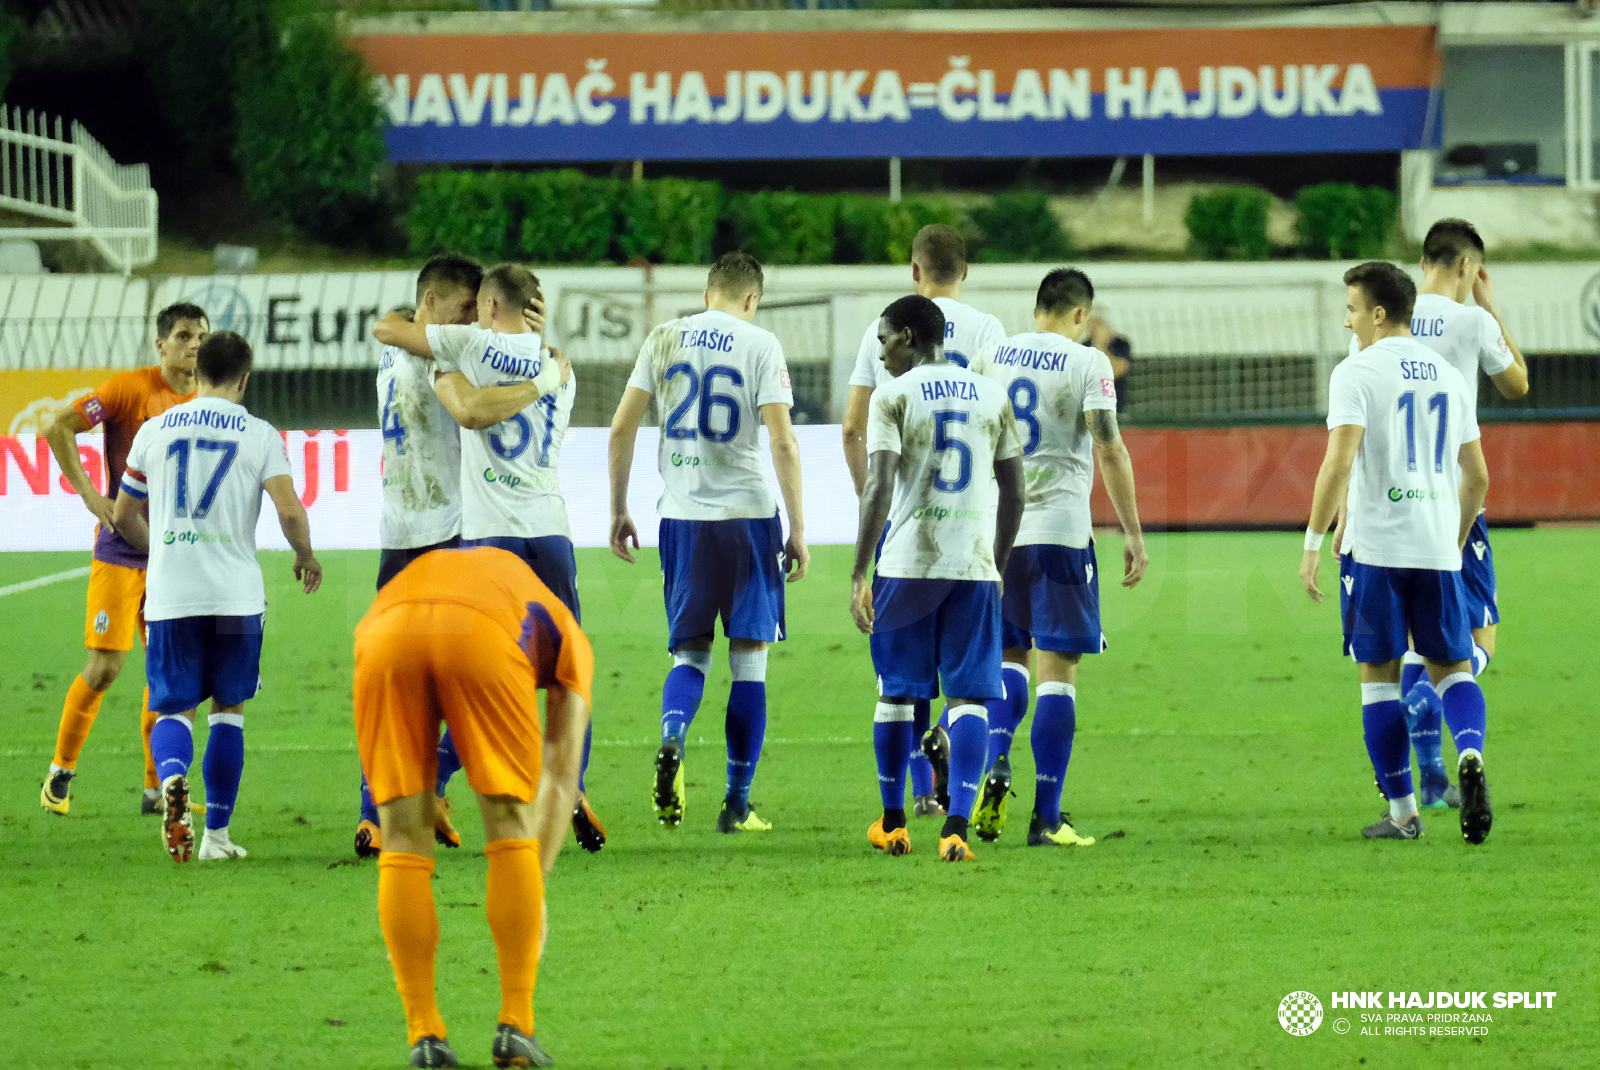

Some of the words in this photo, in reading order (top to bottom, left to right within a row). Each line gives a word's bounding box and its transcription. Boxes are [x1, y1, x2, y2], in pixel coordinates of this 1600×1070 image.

[371, 58, 616, 127] NAVIJAČ
[1104, 63, 1383, 119] HAJDUKA
[481, 345, 541, 380] FOMITS
[679, 328, 734, 352] T.BAŠIĆ
[1400, 358, 1437, 381] ŠEGO
[664, 360, 744, 443] 26
[921, 380, 979, 401] HAMZA
[932, 409, 973, 494] 5
[1397, 390, 1449, 474] 11
[166, 437, 239, 519] 17
